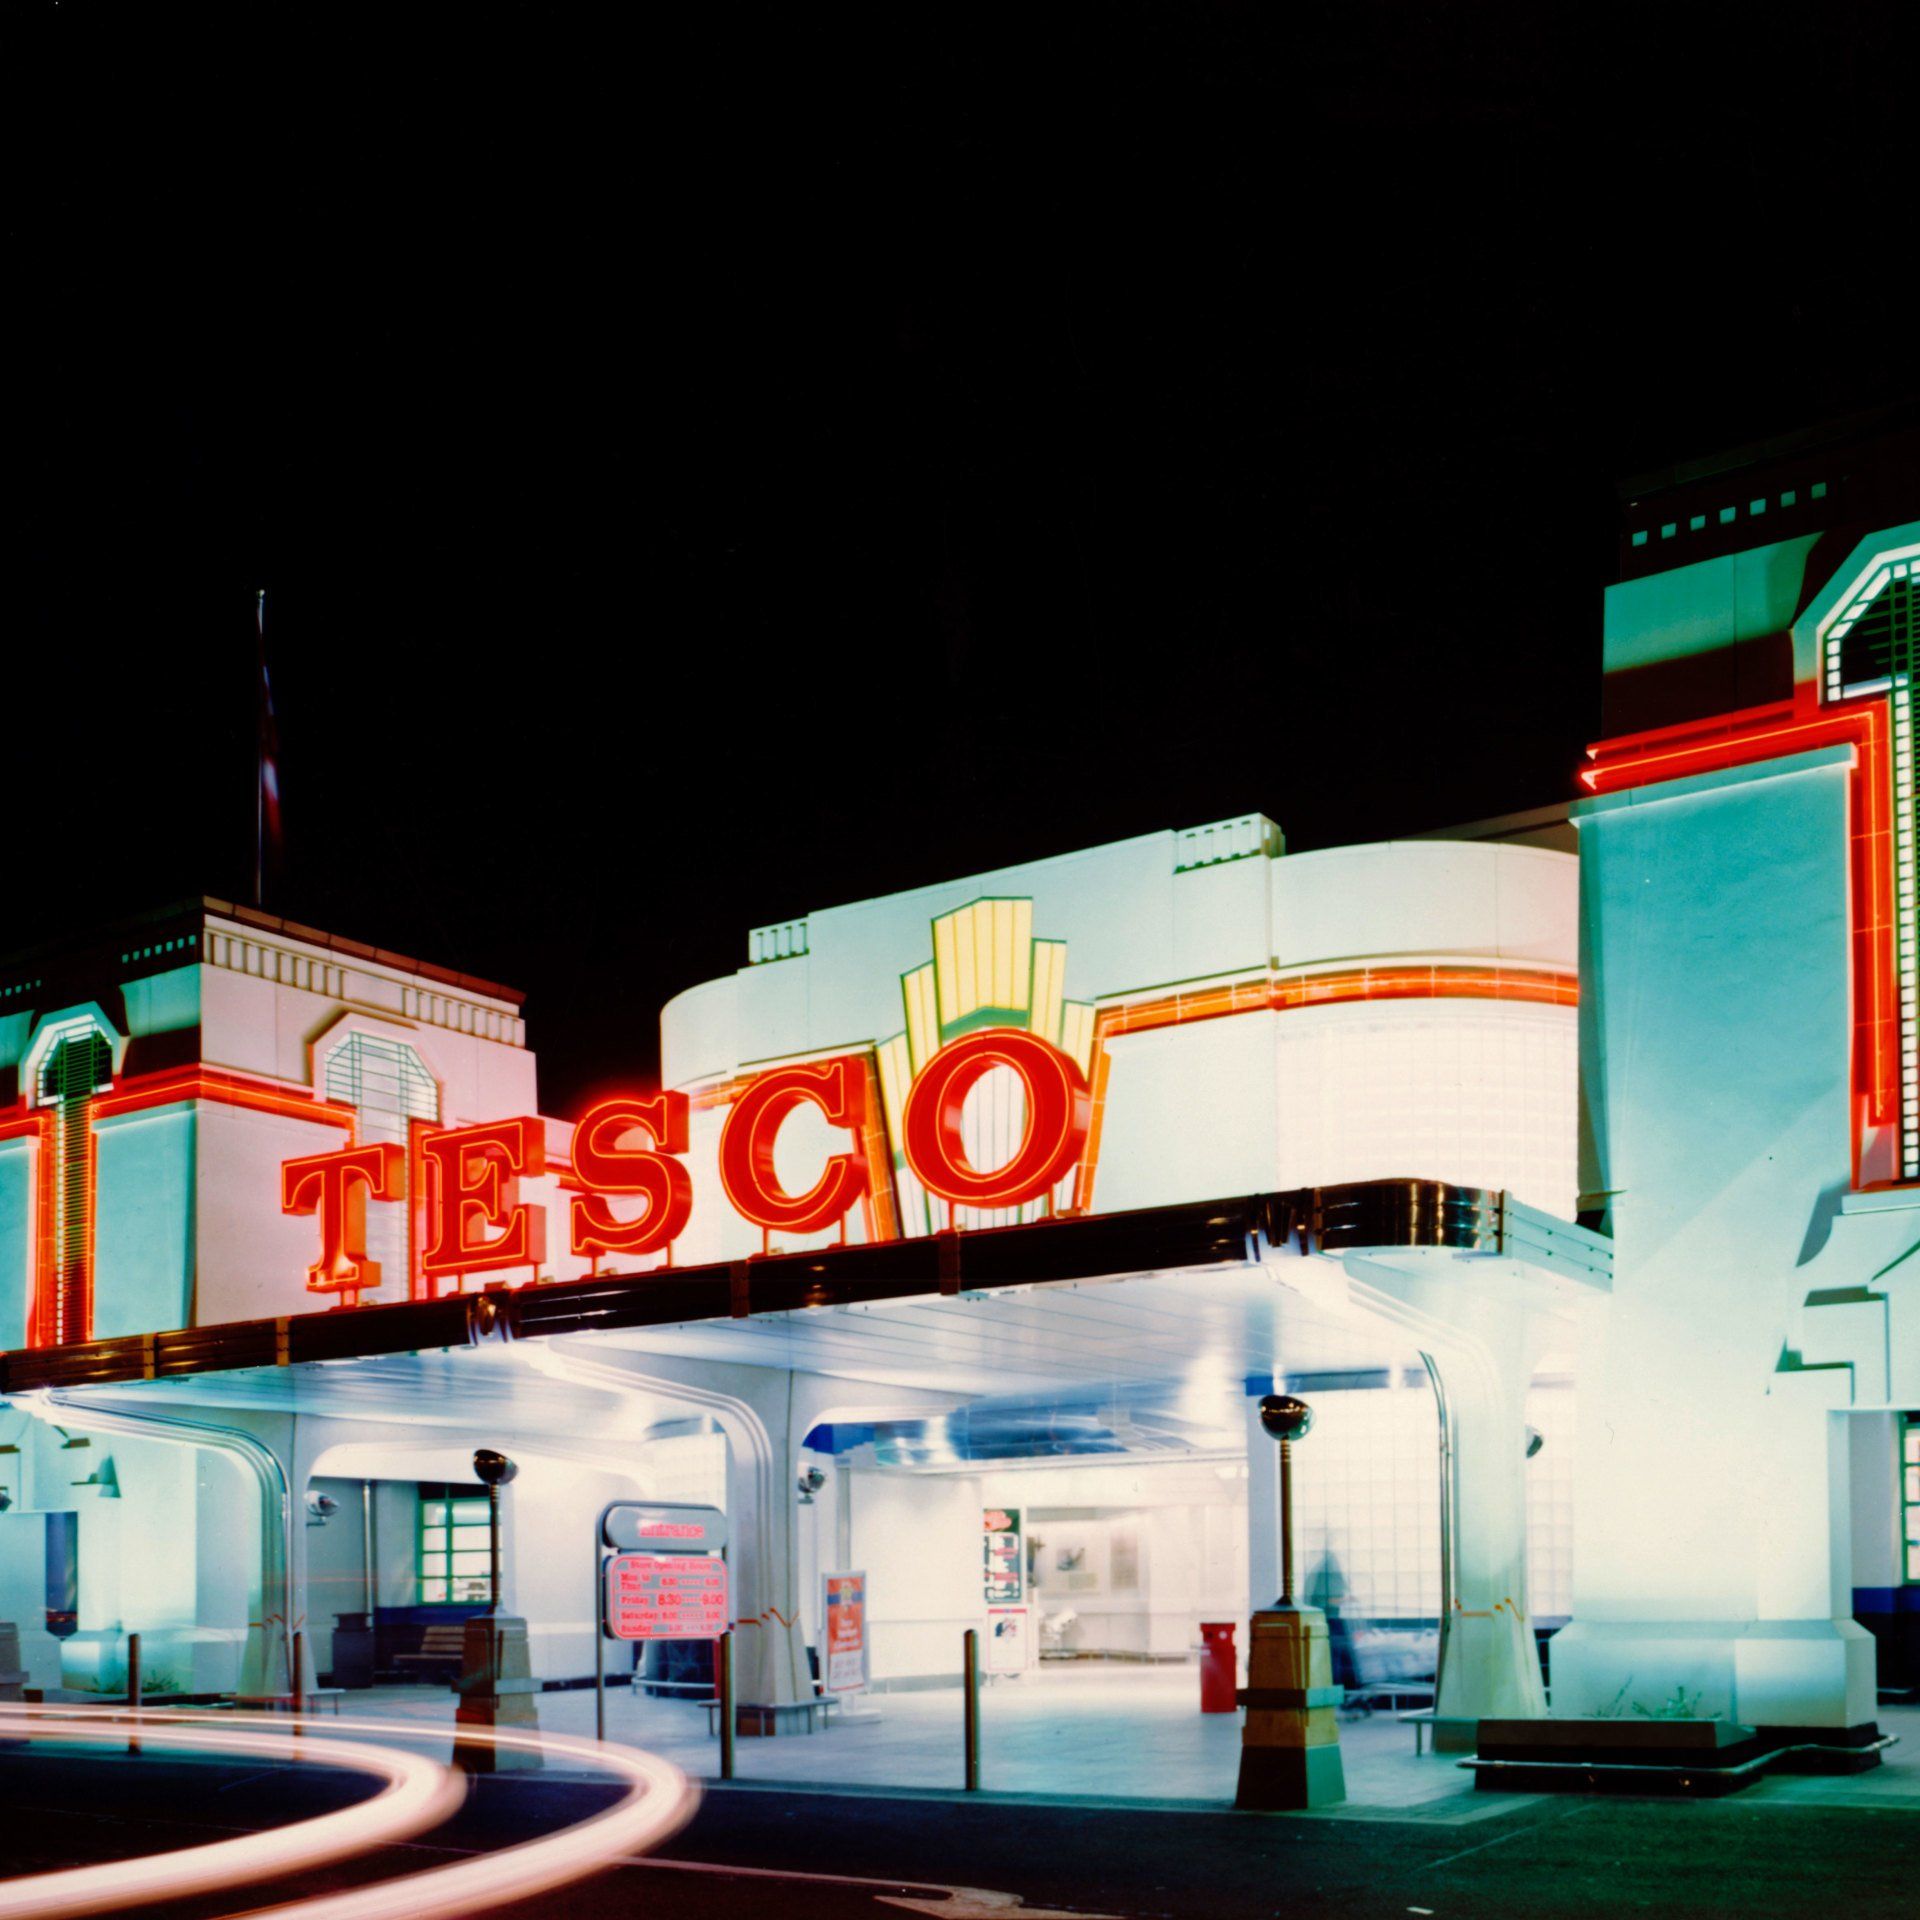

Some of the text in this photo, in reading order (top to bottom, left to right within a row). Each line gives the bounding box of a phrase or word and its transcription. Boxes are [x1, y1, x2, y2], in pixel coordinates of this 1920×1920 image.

[281, 1026, 1090, 1292] TESCO
[621, 1596, 649, 1605] Friday
[658, 1593, 682, 1605] 8.30
[621, 1611, 658, 1622] Saturday
[621, 1625, 652, 1633] Sunday
